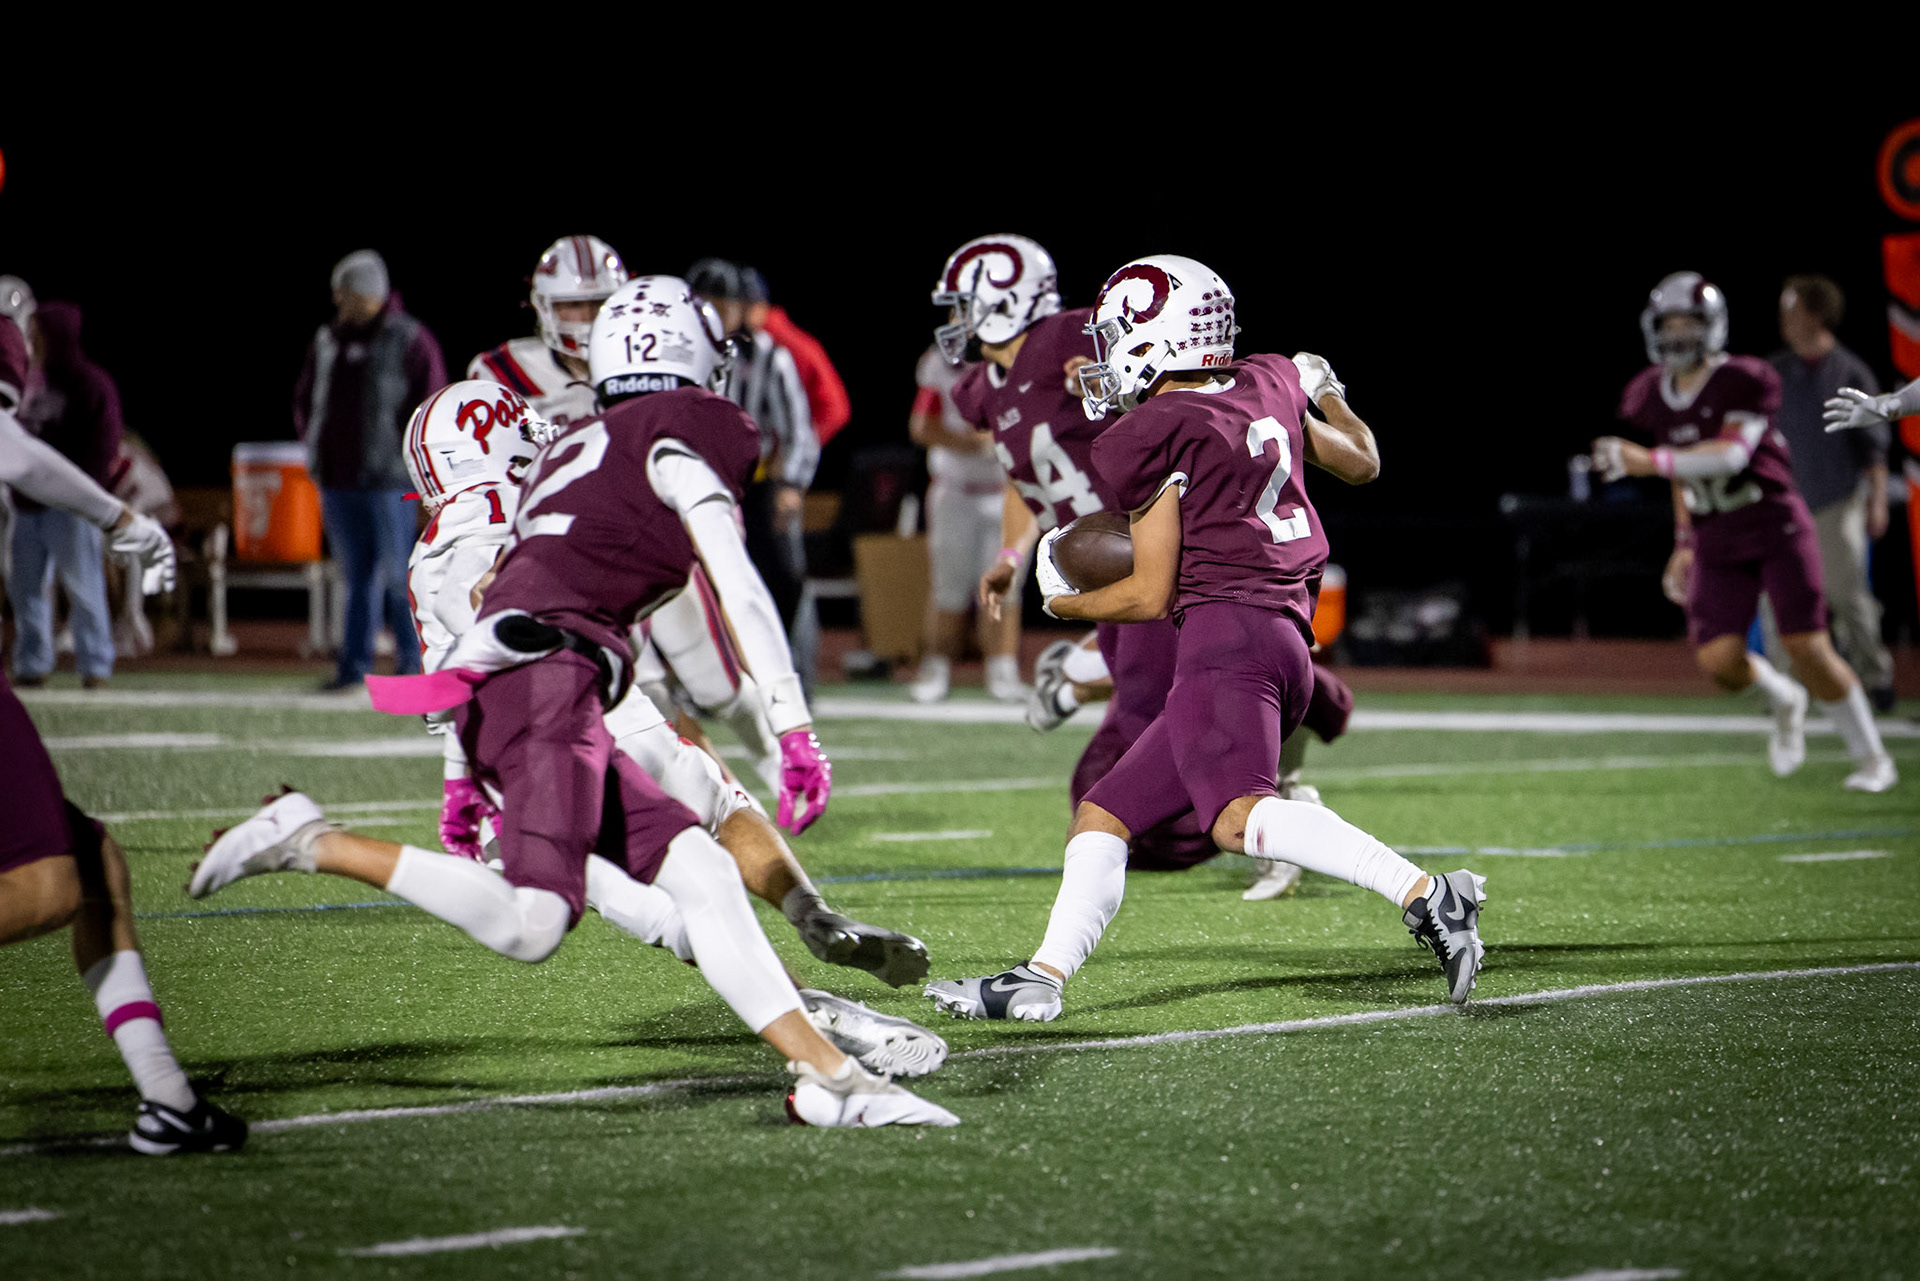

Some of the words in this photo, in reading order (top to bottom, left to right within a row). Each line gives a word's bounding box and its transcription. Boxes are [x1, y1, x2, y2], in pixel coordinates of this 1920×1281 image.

[605, 375, 678, 396] Riddell
[1246, 415, 1312, 544] 2
[485, 489, 507, 525] 1
